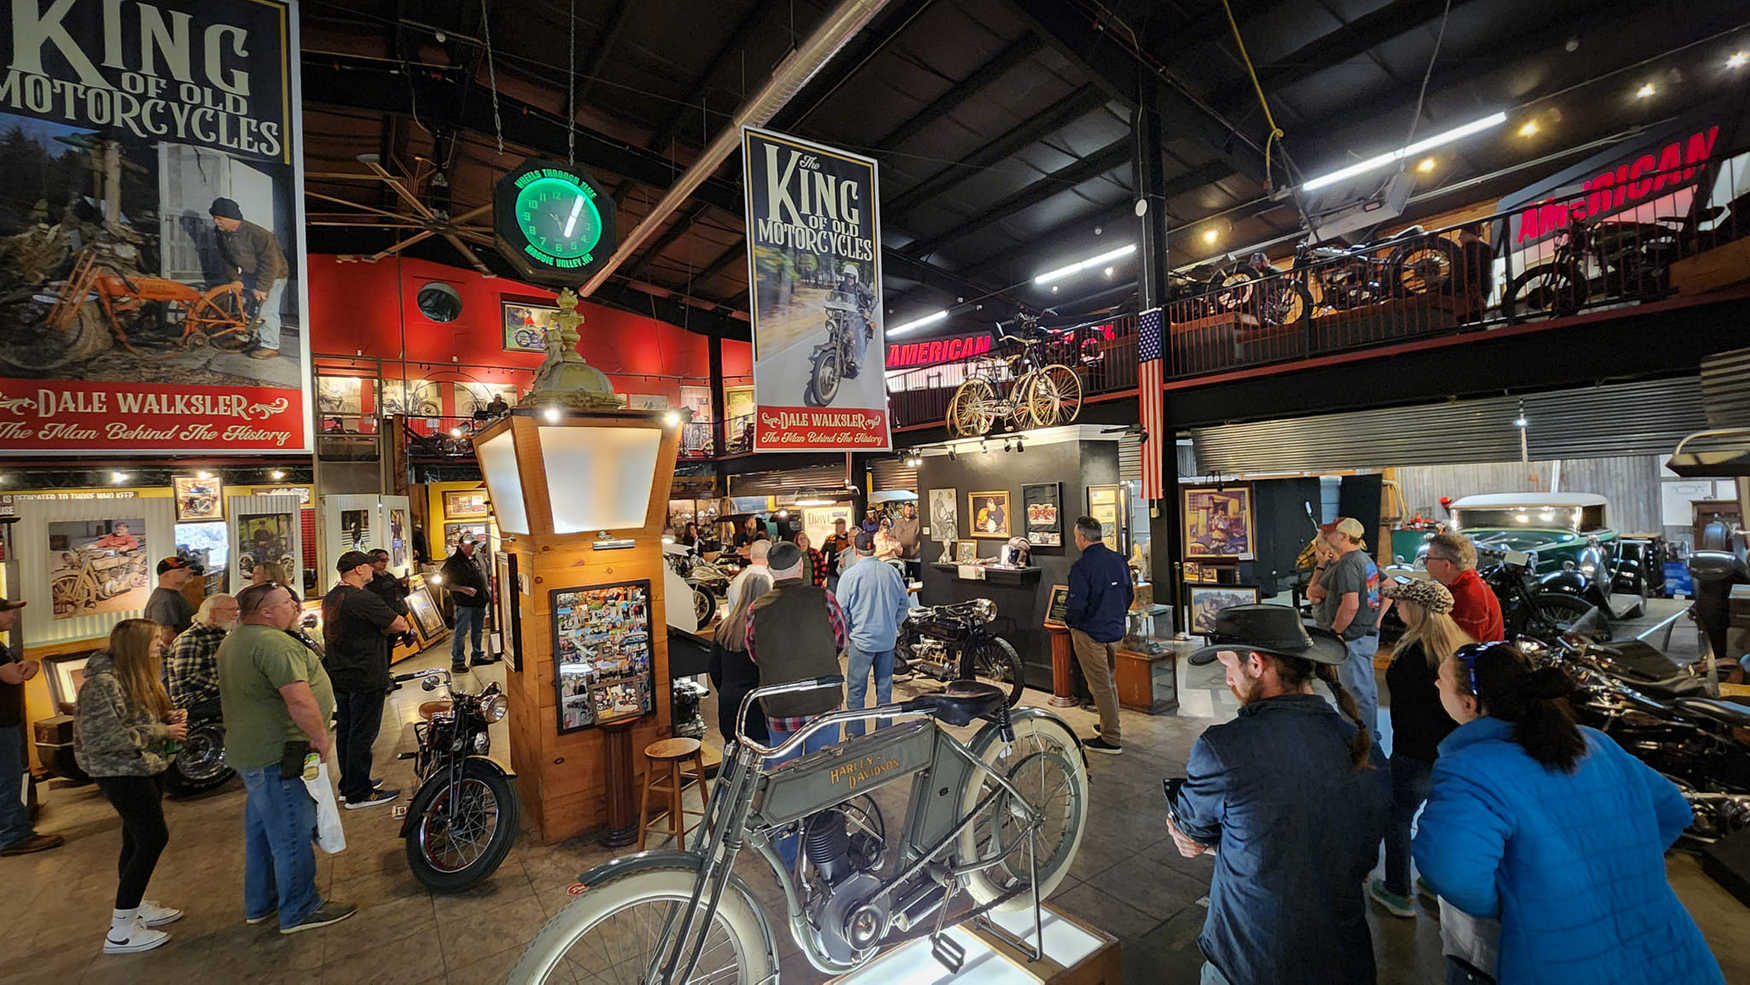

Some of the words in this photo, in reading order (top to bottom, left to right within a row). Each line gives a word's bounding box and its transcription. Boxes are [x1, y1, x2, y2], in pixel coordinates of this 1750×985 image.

[6, 0, 250, 97] KING
[120, 71, 167, 98] OF
[179, 83, 248, 116] OLD
[799, 154, 820, 169] The
[514, 170, 542, 190] WHEELS
[541, 168, 580, 185] THROUGH
[764, 143, 860, 228] KING
[1517, 125, 1719, 244] AMERICAN
[758, 218, 873, 261] MOTORCYCLES
[808, 215, 827, 230] OF
[832, 220, 859, 237] OLD
[886, 335, 991, 368] AMERICAN
[38, 389, 107, 418] DALE
[116, 391, 251, 421] WALKSLER
[780, 411, 809, 430] DALE
[811, 412, 866, 431] WALKSLER
[38, 422, 98, 441] Man
[104, 422, 180, 441] Behind
[179, 424, 217, 441] The
[222, 423, 291, 446] History
[761, 431, 780, 443] The
[780, 431, 806, 443] Man
[807, 431, 835, 443] Behind
[836, 432, 852, 443] The
[854, 432, 883, 446] History
